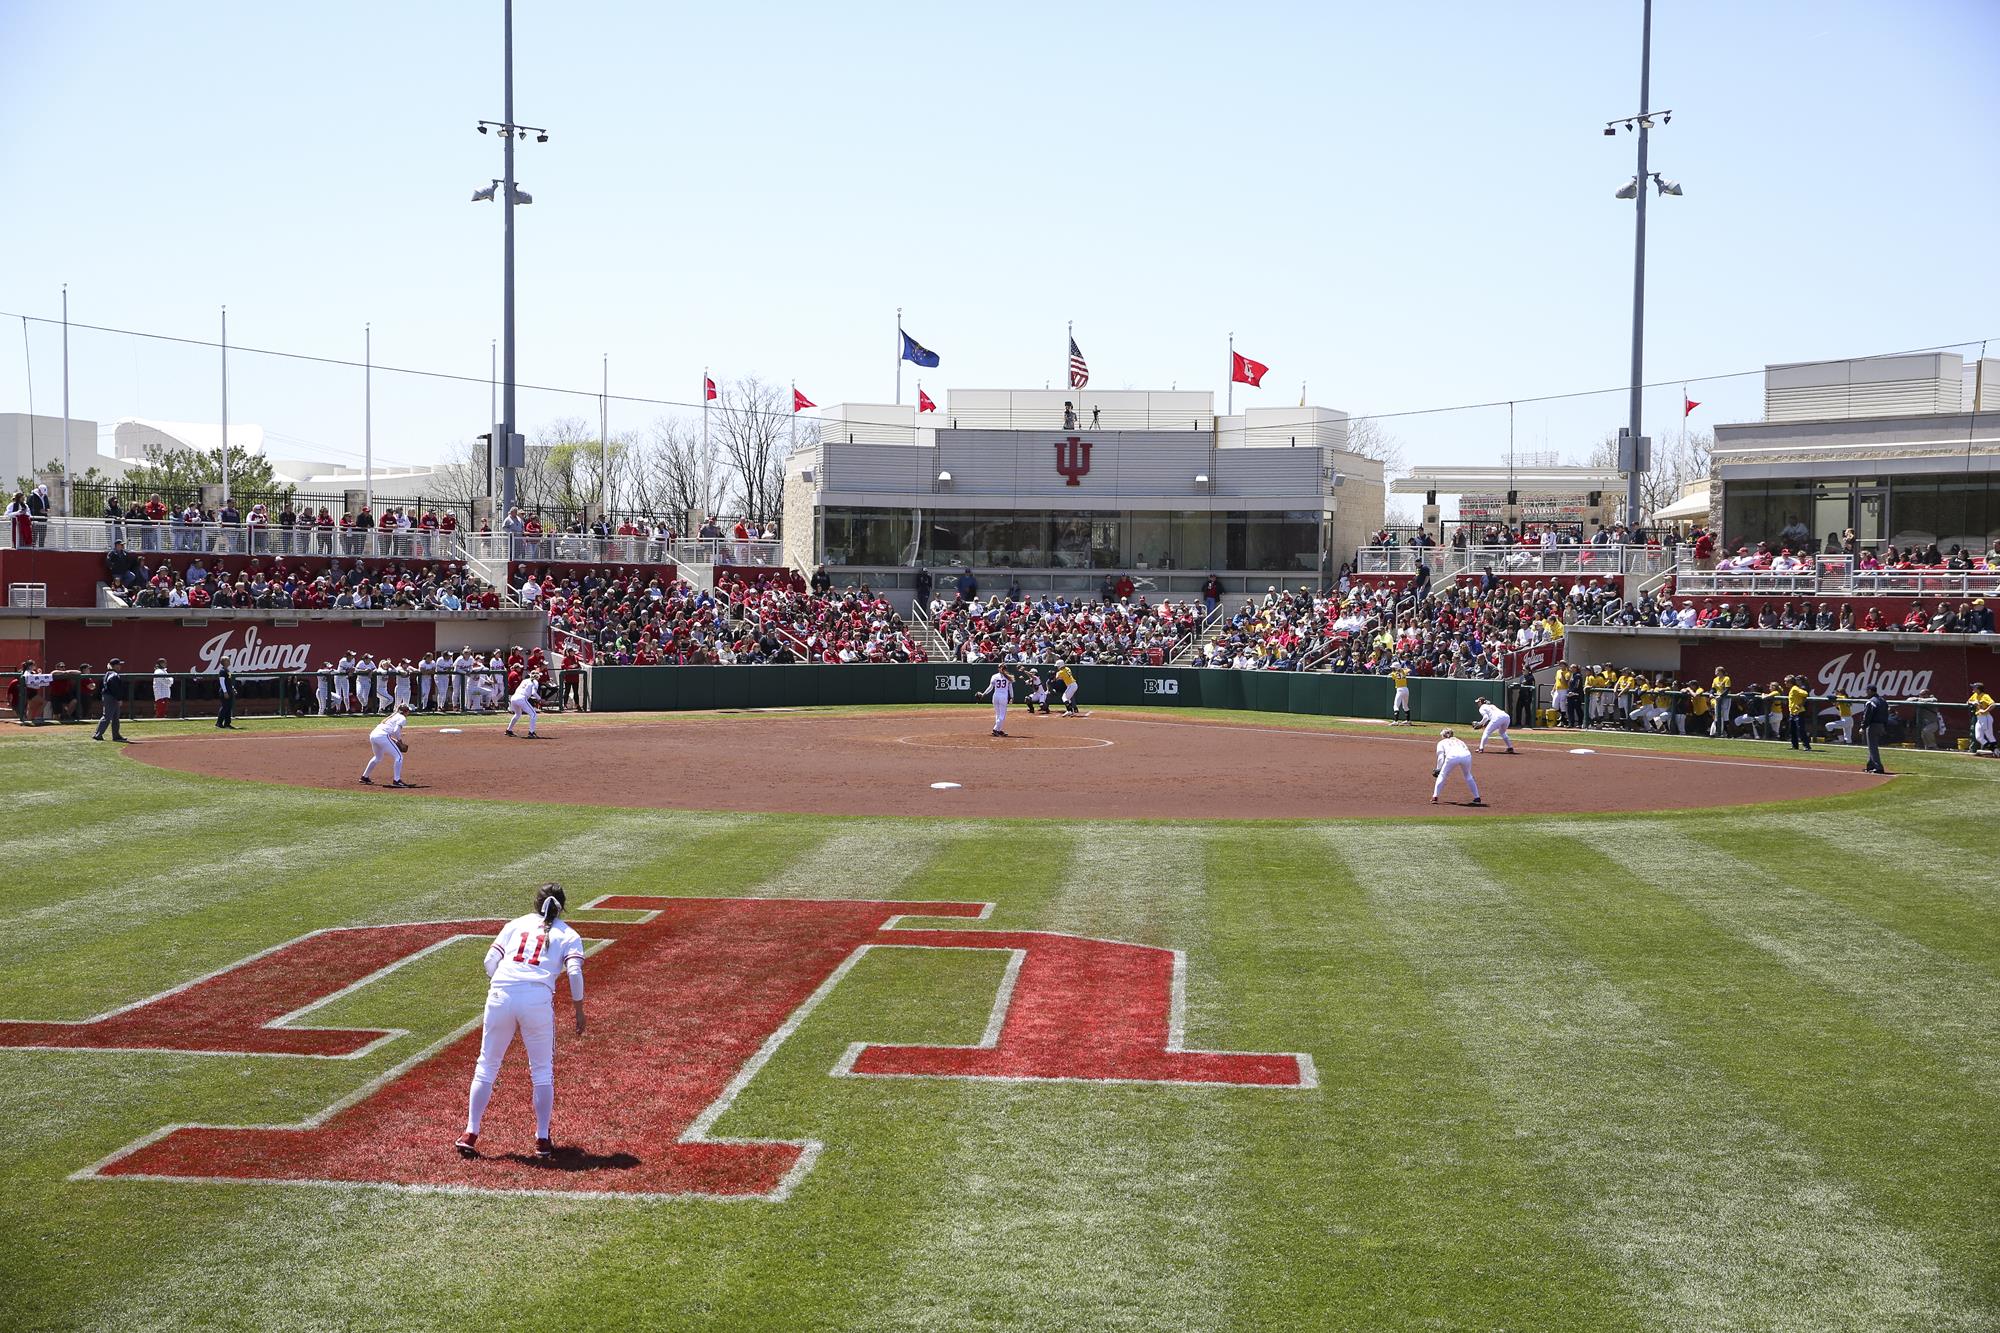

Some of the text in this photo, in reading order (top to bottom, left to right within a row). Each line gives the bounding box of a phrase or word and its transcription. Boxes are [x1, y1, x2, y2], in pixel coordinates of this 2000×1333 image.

[190, 626, 311, 681] Indiana
[1809, 649, 1933, 702] Indiana
[996, 680, 1006, 688] 33
[513, 931, 545, 966] 11
